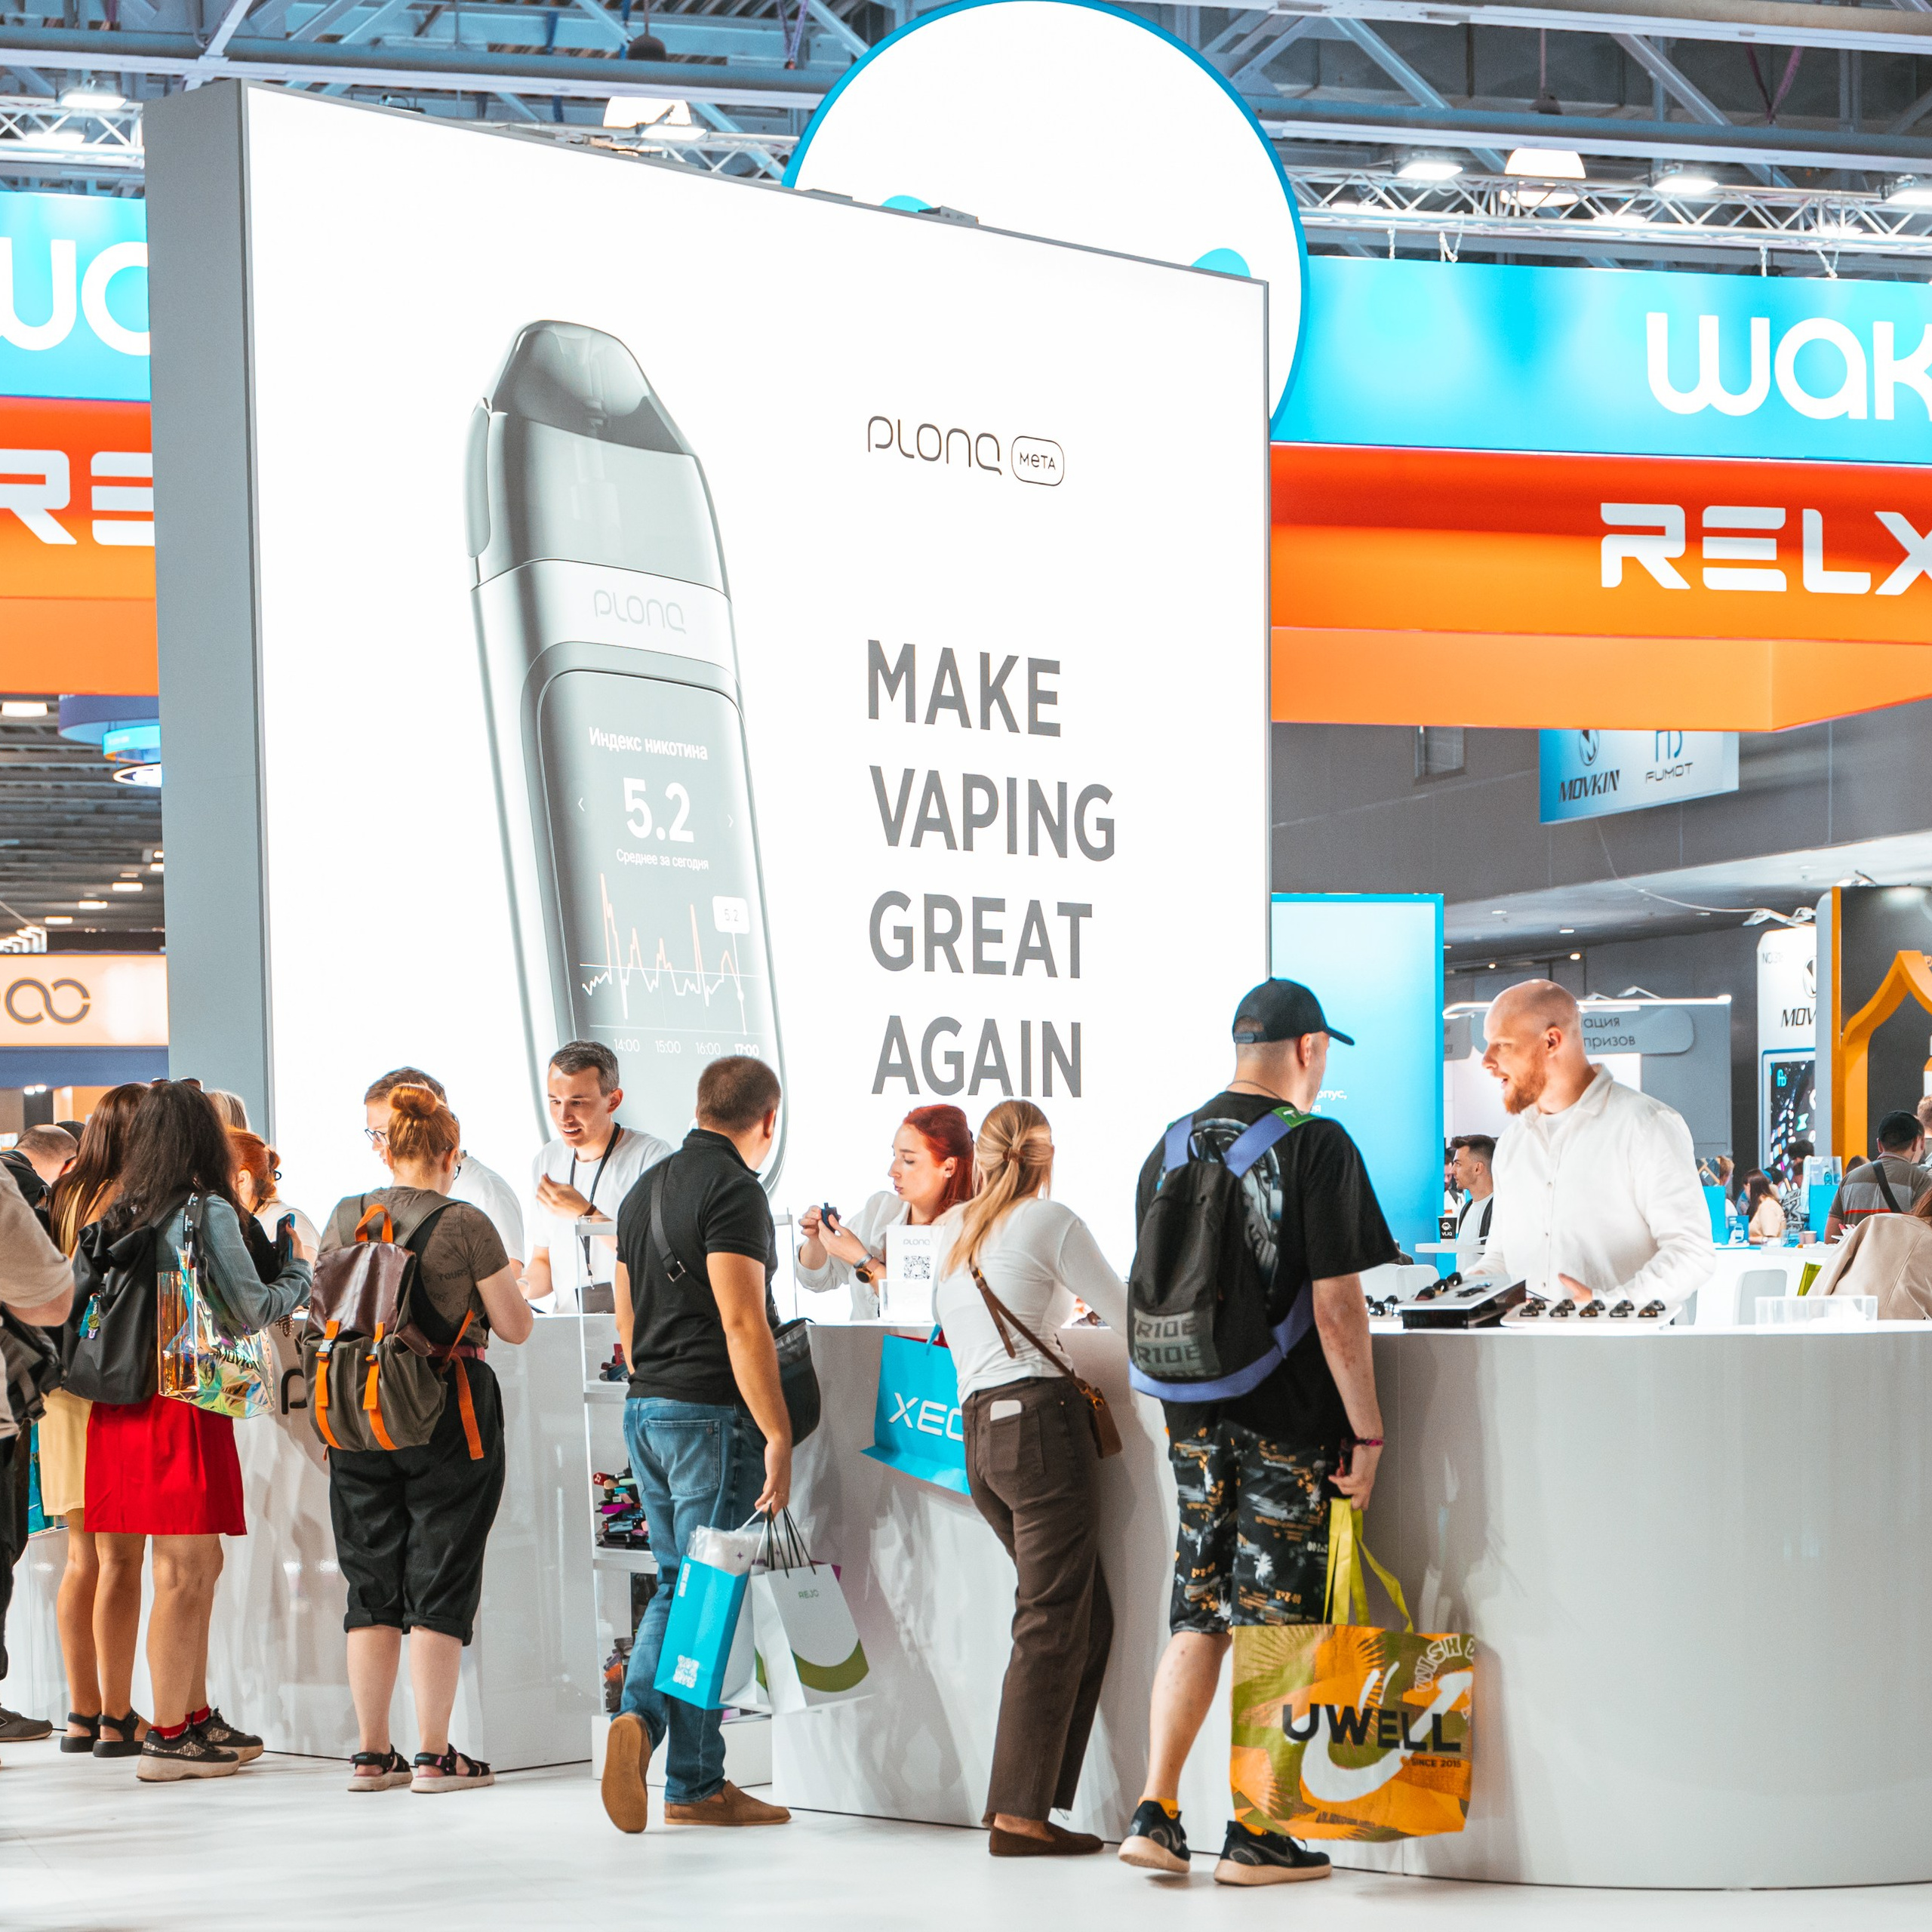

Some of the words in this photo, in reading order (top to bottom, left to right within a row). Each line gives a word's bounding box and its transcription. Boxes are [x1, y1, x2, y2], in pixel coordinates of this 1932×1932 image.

[868, 639, 1061, 737] MAKE
[589, 727, 642, 752] Индекс
[645, 738, 709, 761] никотина
[1558, 769, 1620, 803] MOVKIN
[1645, 762, 1694, 783] FUMOT
[623, 777, 695, 843] 5.2
[869, 765, 1115, 862] VAPING
[616, 848, 658, 866] Среднее
[659, 855, 671, 866] за
[672, 857, 709, 871] сегодня
[869, 891, 1093, 979] GREAT
[1582, 1017, 1620, 1029] ация
[614, 1038, 640, 1053] 14:00
[655, 1040, 681, 1054] 15:00
[695, 1042, 721, 1056] 16:00
[734, 1043, 760, 1057] 17:00
[871, 1014, 1082, 1098] AGAIN
[1583, 1035, 1636, 1050] призов
[1282, 1703, 1462, 1753] UWELL
[1411, 1758, 1437, 1768] SINCE
